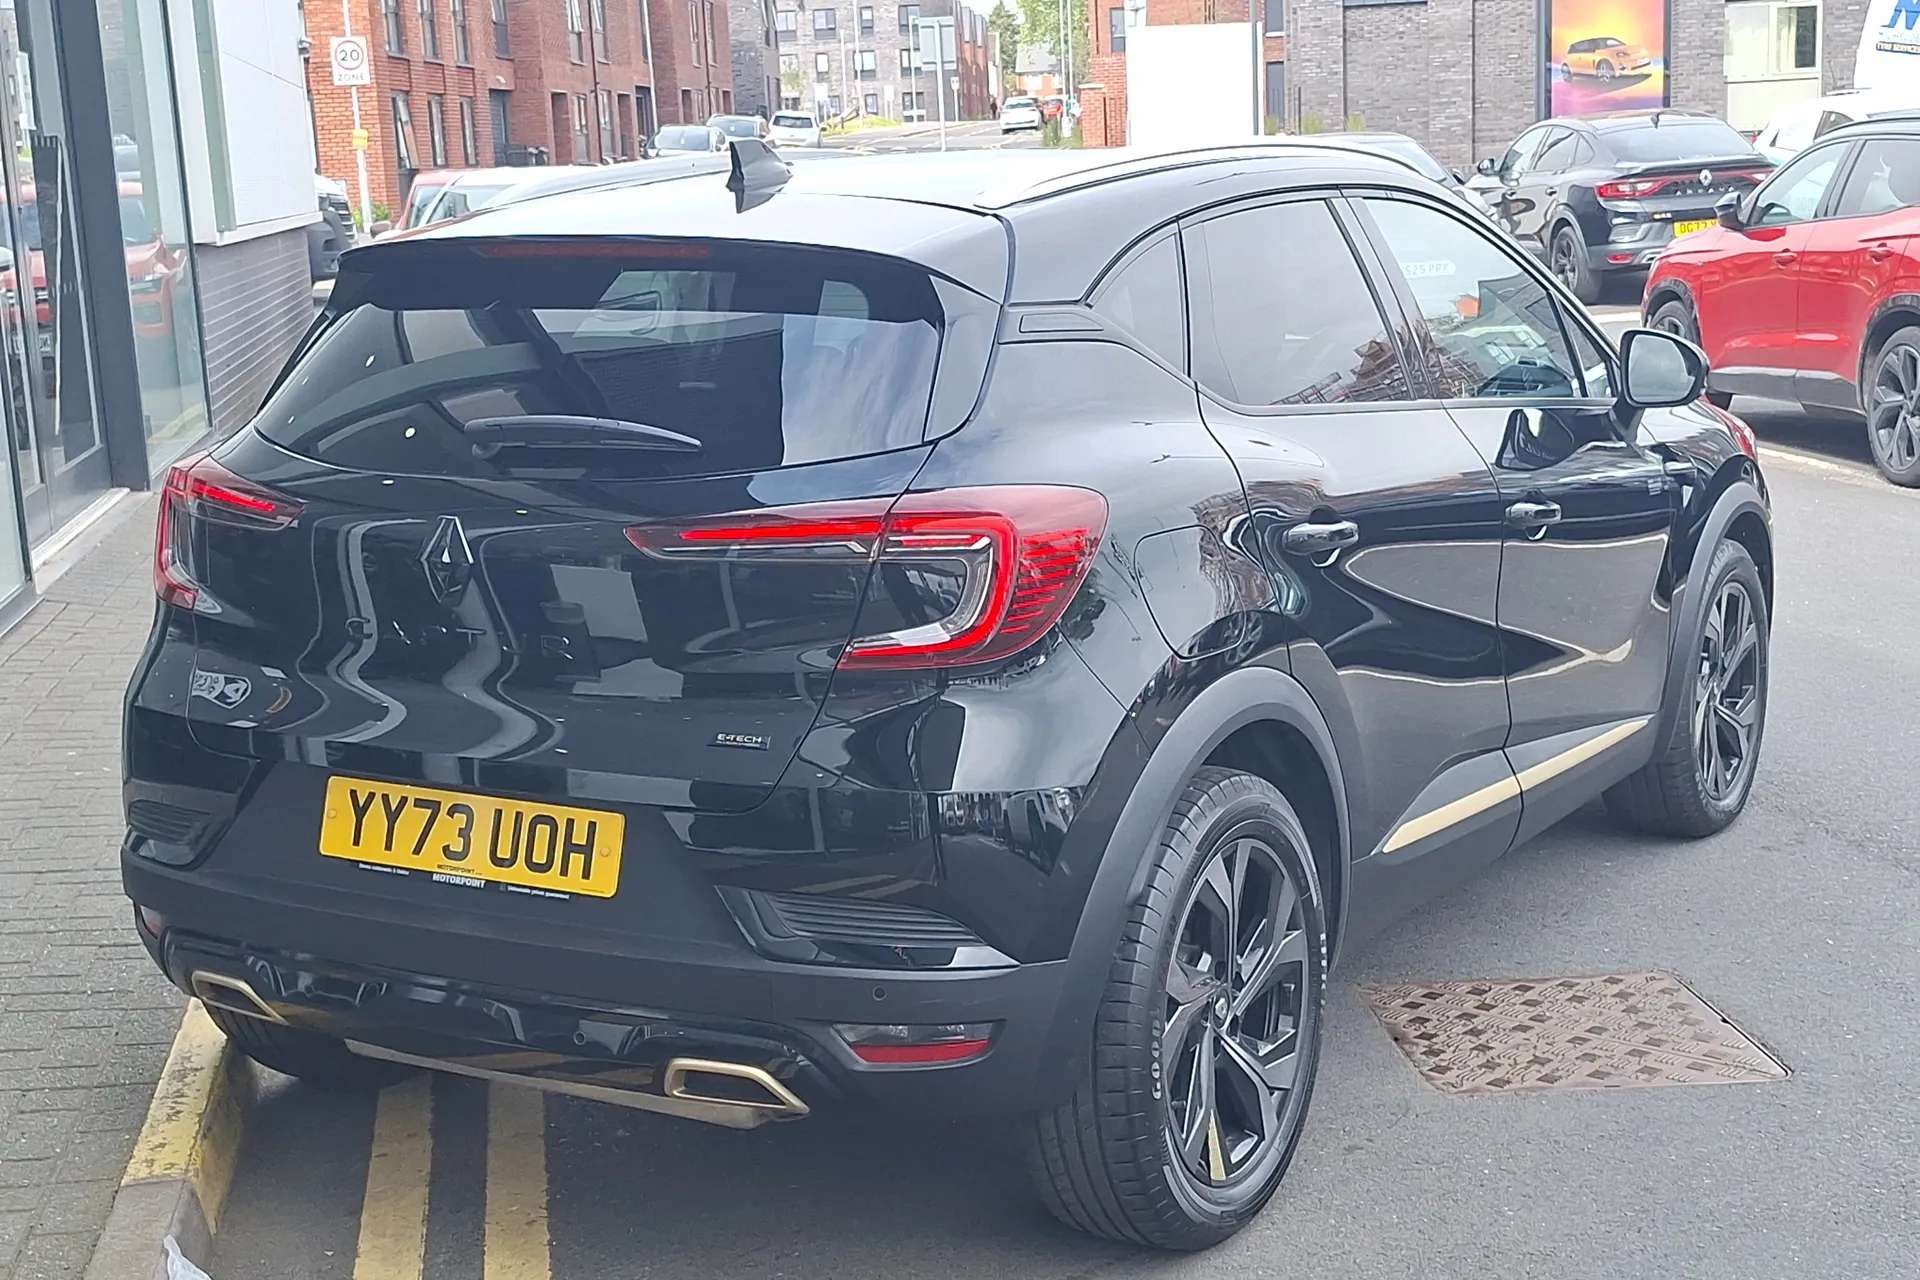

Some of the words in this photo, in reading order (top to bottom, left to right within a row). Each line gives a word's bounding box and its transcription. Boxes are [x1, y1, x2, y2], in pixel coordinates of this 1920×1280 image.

[340, 49, 360, 61] 20
[337, 73, 365, 81] ZONE
[717, 734, 762, 743] E-TECH
[349, 789, 474, 861] YY73
[489, 809, 597, 880] UOH
[432, 873, 486, 888] MOTORPOINT
